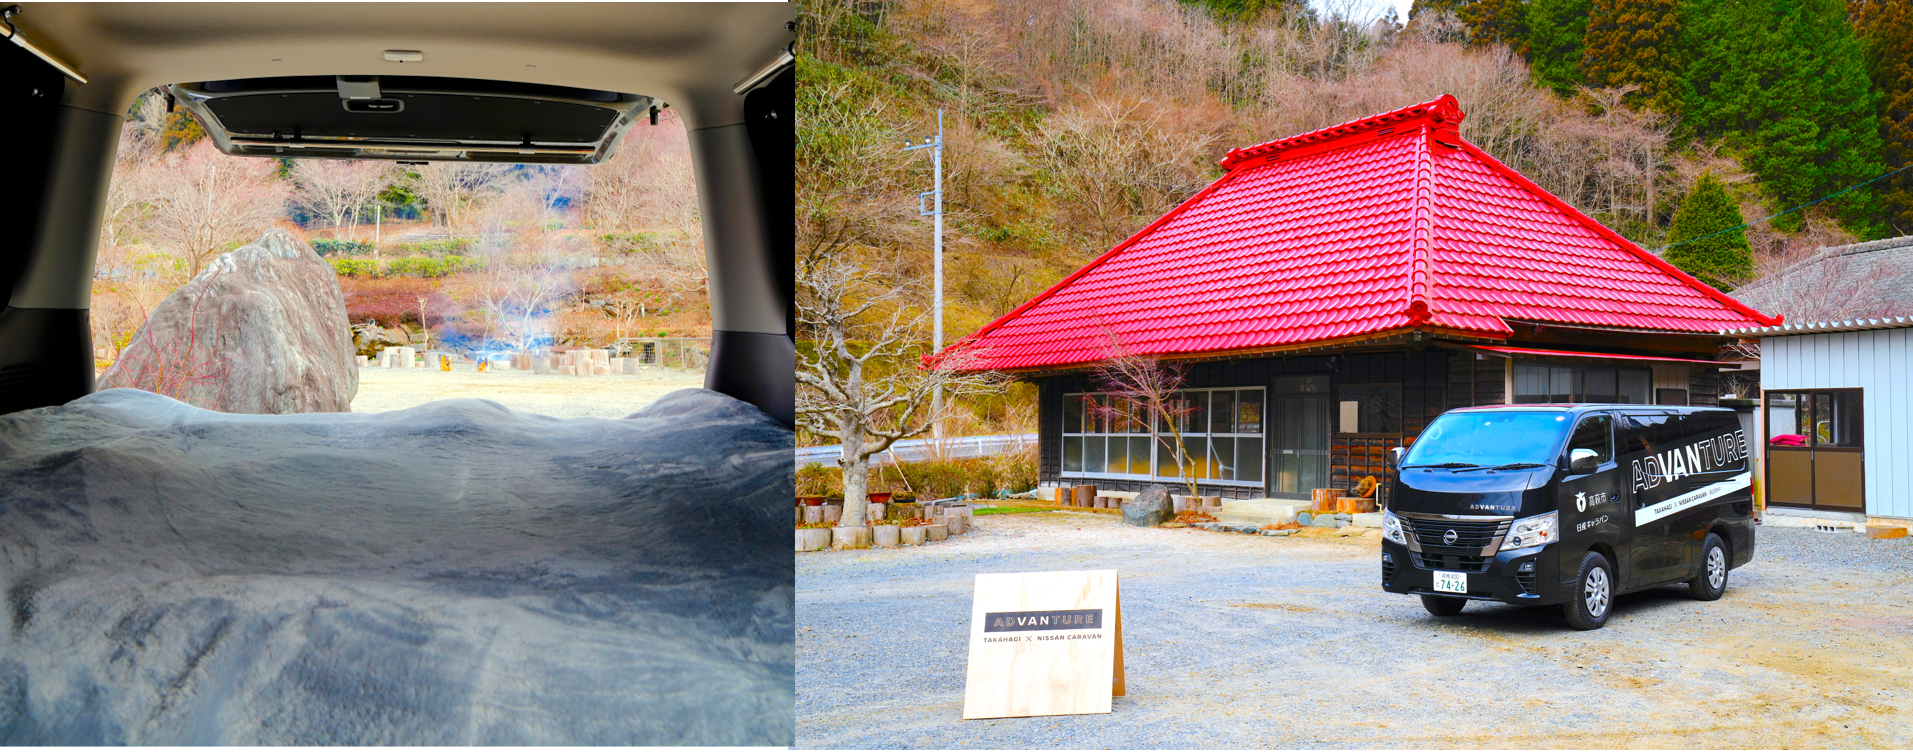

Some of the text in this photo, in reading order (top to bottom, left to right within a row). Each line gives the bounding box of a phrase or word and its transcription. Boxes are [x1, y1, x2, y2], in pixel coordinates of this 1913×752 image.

[1632, 429, 1748, 494] ADVANTURE
[1589, 492, 1606, 507] 高萩市
[1577, 515, 1609, 532] 日産キャラバン
[1441, 579, 1465, 591] 74-26
[994, 614, 1094, 627] ADVANTURE
